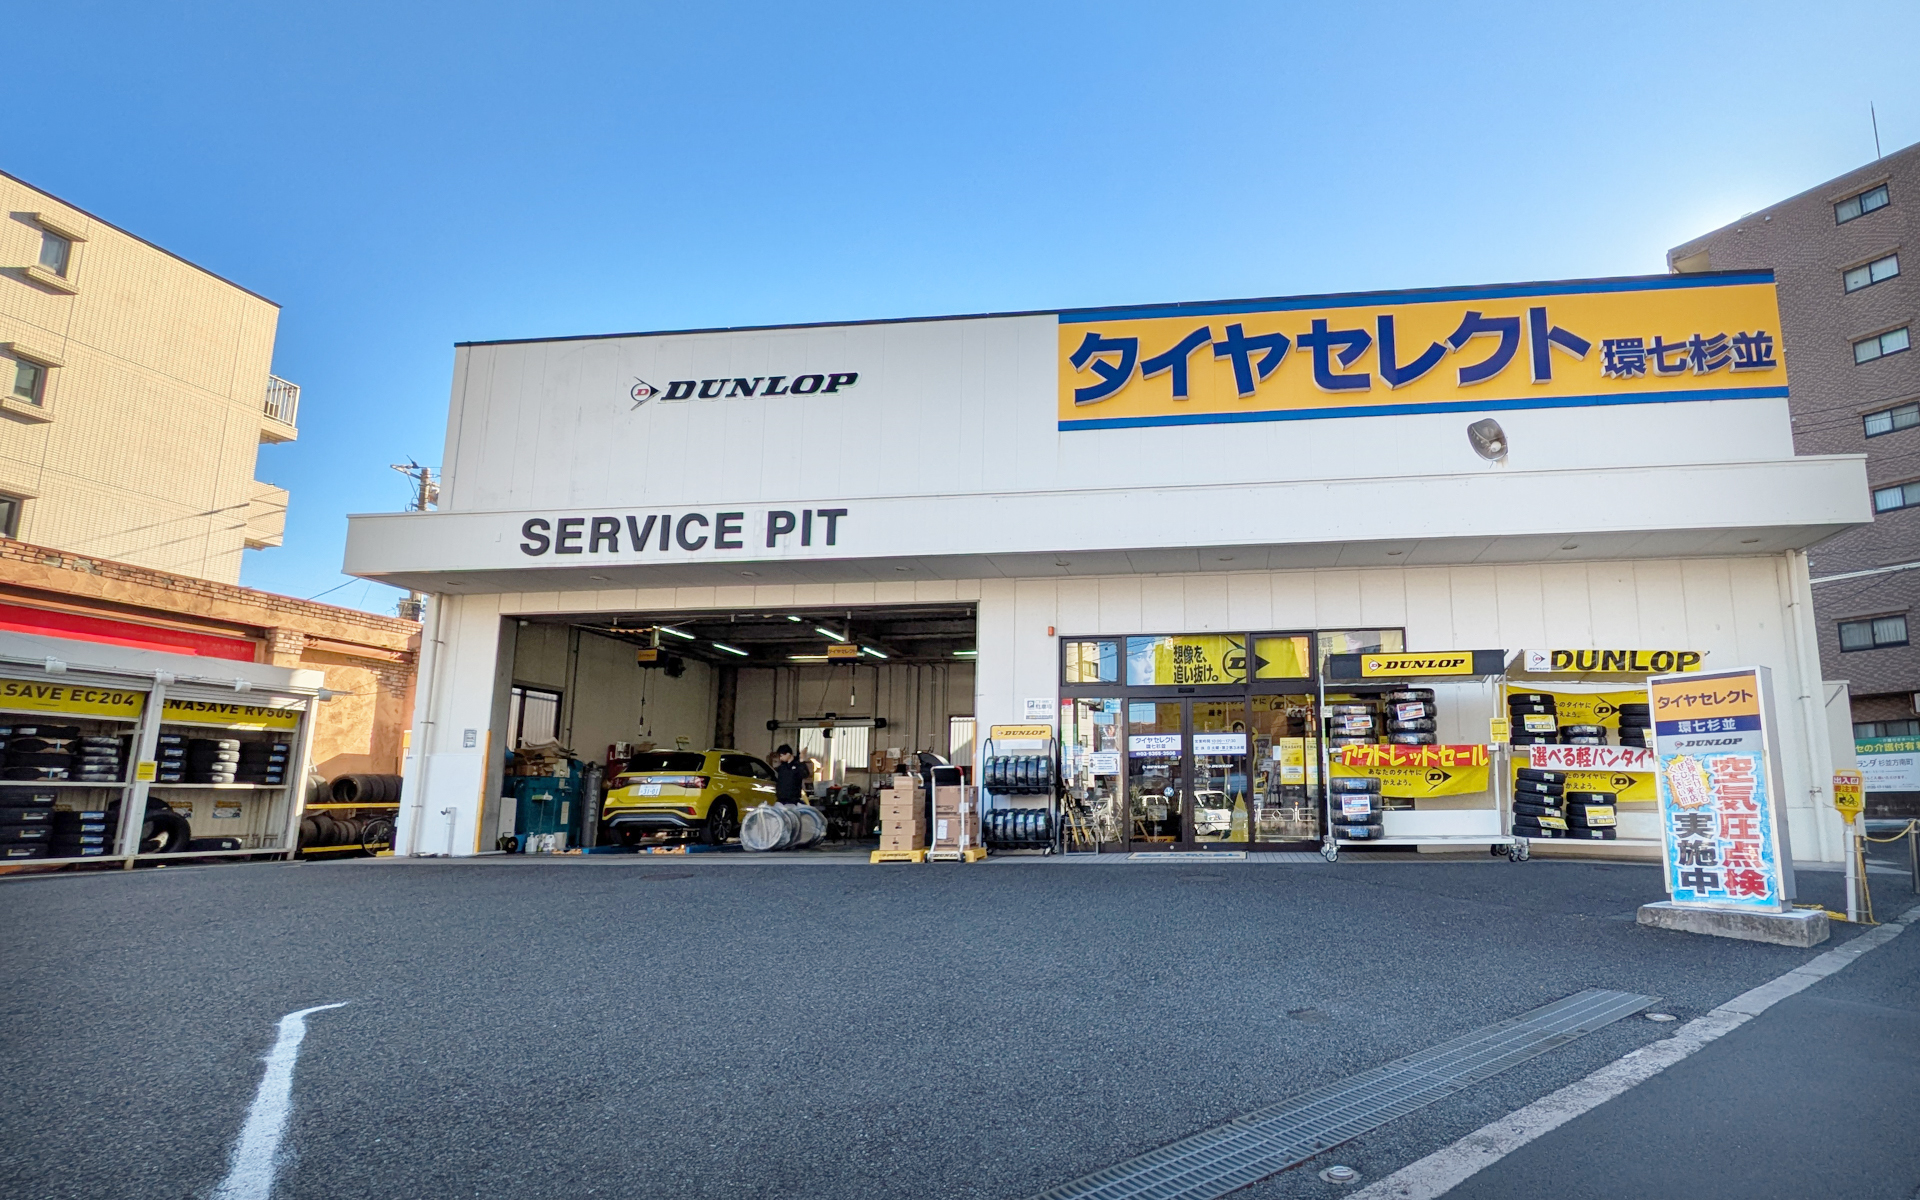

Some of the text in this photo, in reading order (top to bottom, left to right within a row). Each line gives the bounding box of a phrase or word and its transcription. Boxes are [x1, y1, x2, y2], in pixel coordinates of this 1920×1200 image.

[1069, 306, 1777, 406] タイヤセレクト 環七杉並
[660, 371, 859, 402] DUNLOP
[520, 508, 848, 556] SERVICE PIT
[1173, 645, 1207, 664] 想像を、
[1384, 659, 1465, 670] DUNLOP
[1551, 650, 1701, 672] DUNLOP
[1173, 664, 1219, 684] 追い抜け。
[0, 683, 135, 706] SAVE EC204
[1657, 689, 1754, 709] タイヤセレクト
[245, 705, 294, 719] RV505
[1677, 718, 1737, 733] 環七杉並
[1685, 738, 1743, 748] DUNLOP
[1341, 744, 1489, 766] アウトレットセール
[1368, 768, 1422, 776] あなたのタイヤに
[1383, 779, 1412, 787] かえよう。
[1711, 757, 1767, 897] 空気圧点検
[1674, 812, 1720, 894] 実施中
